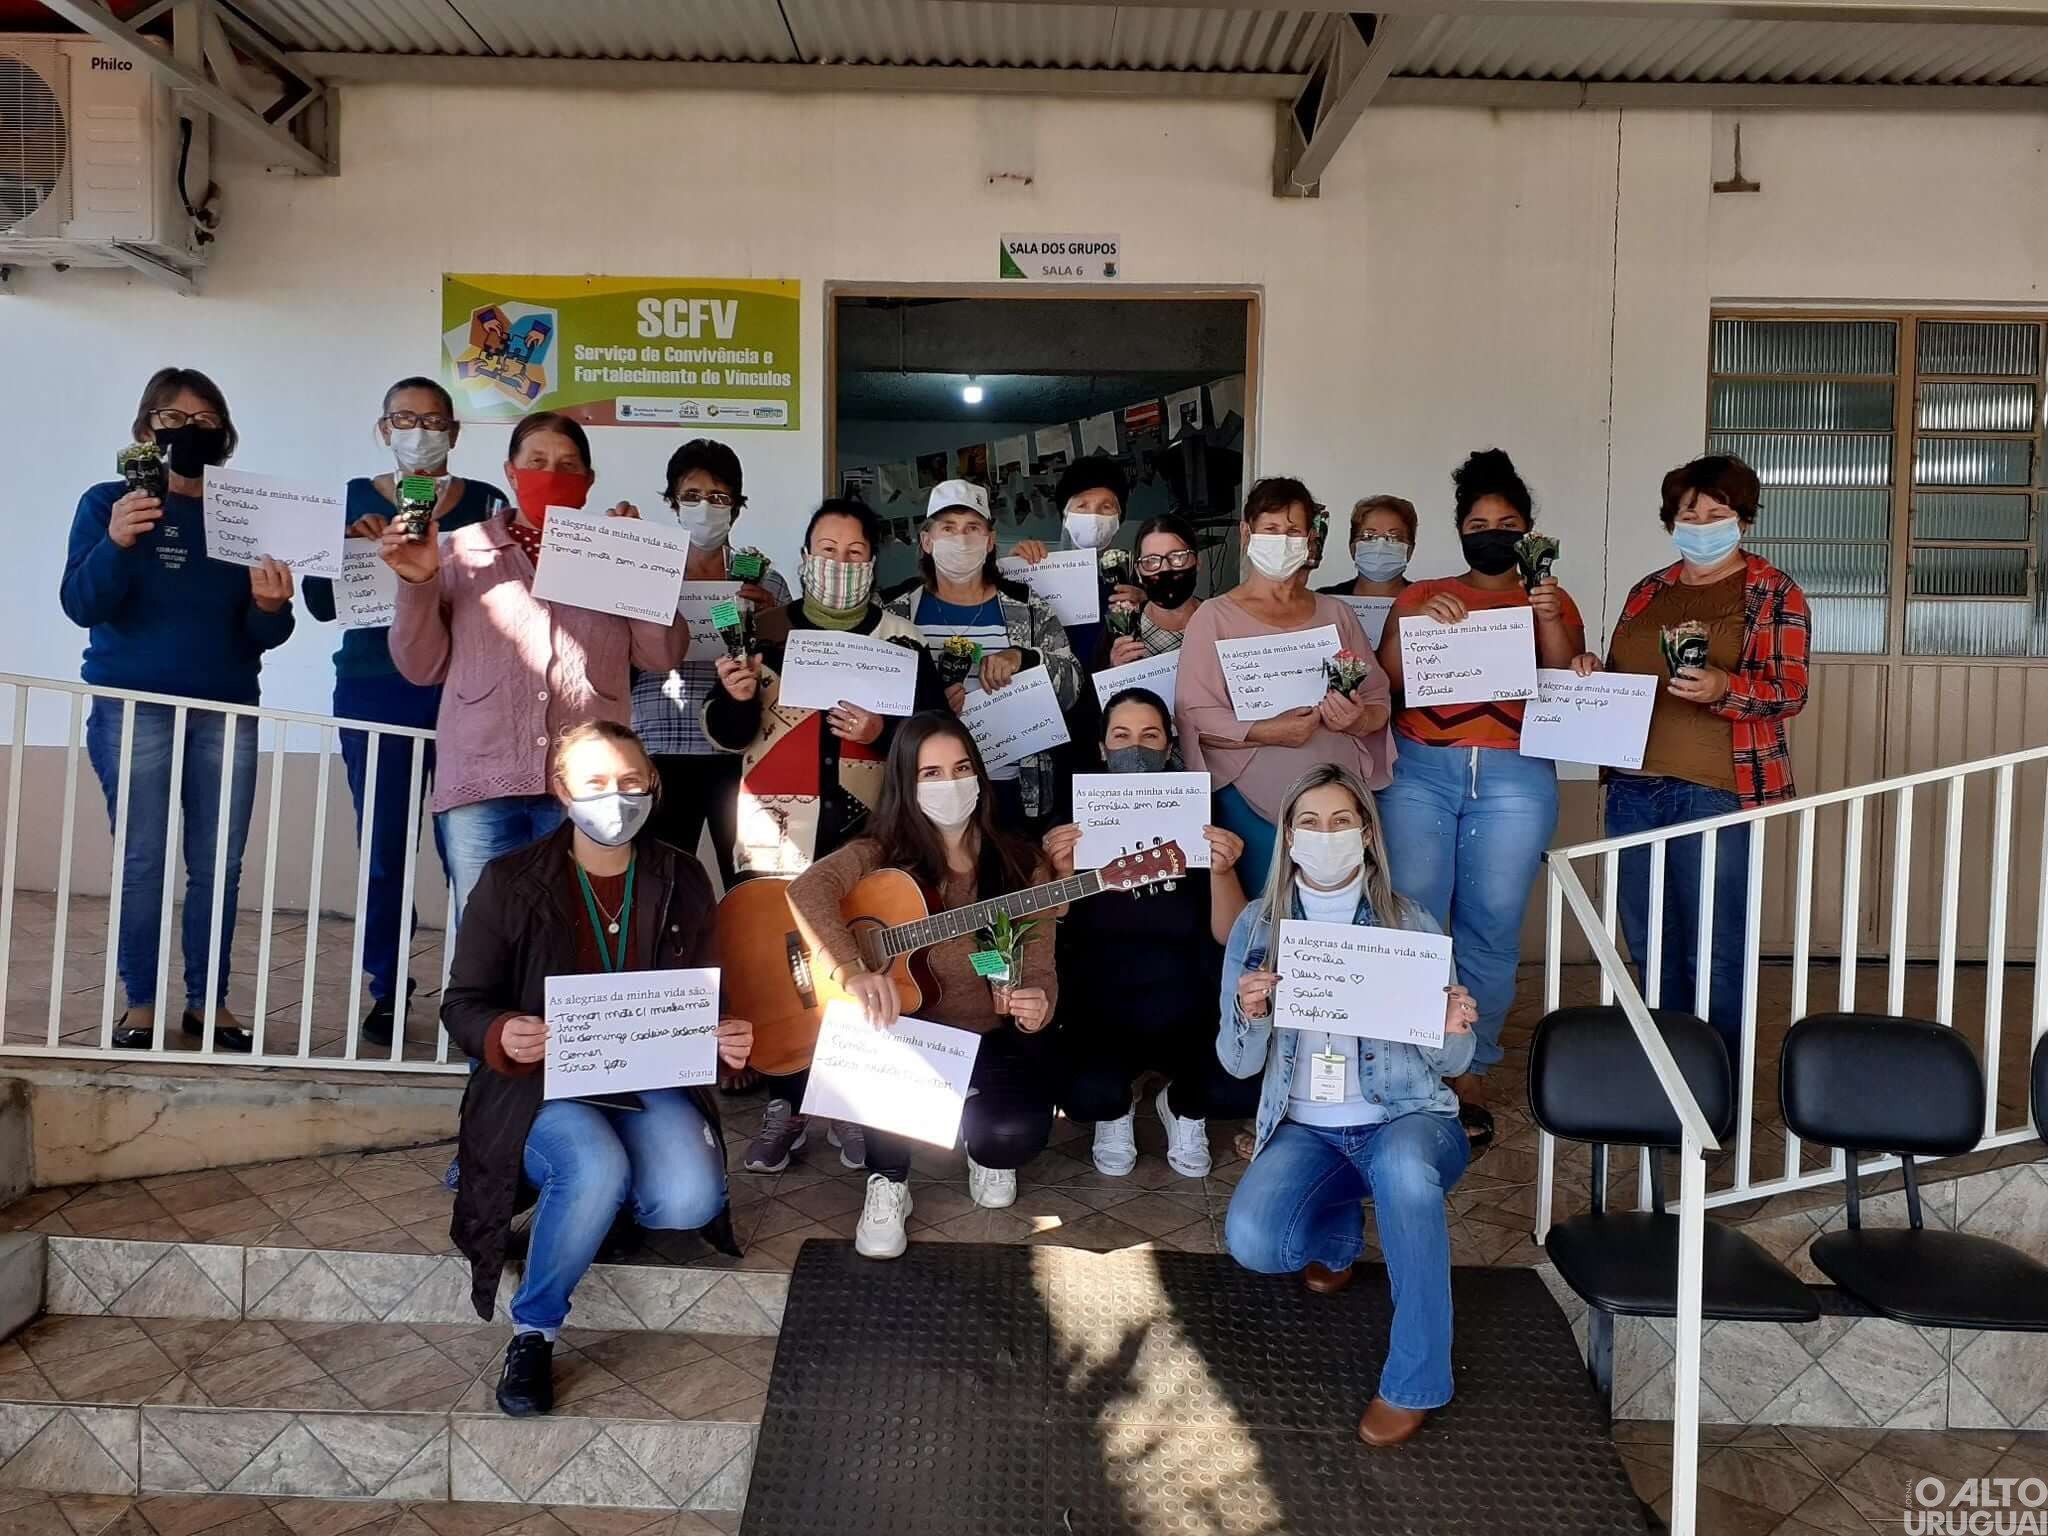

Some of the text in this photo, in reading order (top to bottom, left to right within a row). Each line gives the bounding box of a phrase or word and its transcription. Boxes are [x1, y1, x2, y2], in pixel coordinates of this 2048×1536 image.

[91, 57, 132, 70] Philco
[1010, 243, 1117, 254] SALA DOS GRUPOS
[1042, 266, 1083, 276] SALA 6
[637, 298, 739, 339] SCFV
[574, 344, 773, 364] Serviço de Convivência e
[574, 366, 791, 386] Fortalecimento de Vínculos
[207, 480, 217, 488] As
[220, 483, 254, 494] alegrias
[256, 488, 267, 496] da
[269, 491, 298, 501] minha
[549, 516, 558, 525] As
[561, 519, 597, 533] alegrias
[599, 526, 609, 534] da
[611, 529, 640, 542] minha
[642, 536, 660, 548] vida
[1039, 562, 1060, 570] minha
[1062, 560, 1076, 568] vida
[615, 601, 660, 618] Clementina
[1414, 628, 1446, 639] alegrias
[1448, 626, 1458, 634] da
[1460, 624, 1487, 633] minha
[1489, 623, 1507, 631] vida
[801, 639, 833, 647] alegrias
[848, 643, 873, 652] minha
[1232, 649, 1261, 659] alegrias
[1262, 647, 1272, 655] da
[1274, 645, 1298, 653] minha
[1299, 641, 1316, 649] vida
[1109, 677, 1136, 688] alegrias
[1148, 667, 1171, 677] minha
[983, 700, 992, 708] da
[992, 691, 1013, 704] minha
[1014, 684, 1029, 694] vida
[1543, 682, 1572, 692] alegrias
[1584, 685, 1610, 694] minha
[1612, 687, 1629, 695] vida
[1076, 789, 1087, 797] As
[1088, 788, 1120, 798] alegrias
[1122, 787, 1133, 796] da
[1135, 787, 1162, 796] minha
[1165, 786, 1183, 795] vida
[1283, 935, 1446, 961] As alegrias da minha vida são...
[550, 996, 562, 1006] As
[566, 995, 608, 1006] alegrias
[610, 992, 623, 1001] da
[627, 989, 660, 1000] minha
[664, 987, 686, 998] vida
[1289, 1003, 1349, 1023] Profissão
[893, 1031, 923, 1048] minha
[926, 1039, 946, 1053] vida
[1409, 1028, 1441, 1041] Pricila
[678, 1069, 713, 1080] Silvana
